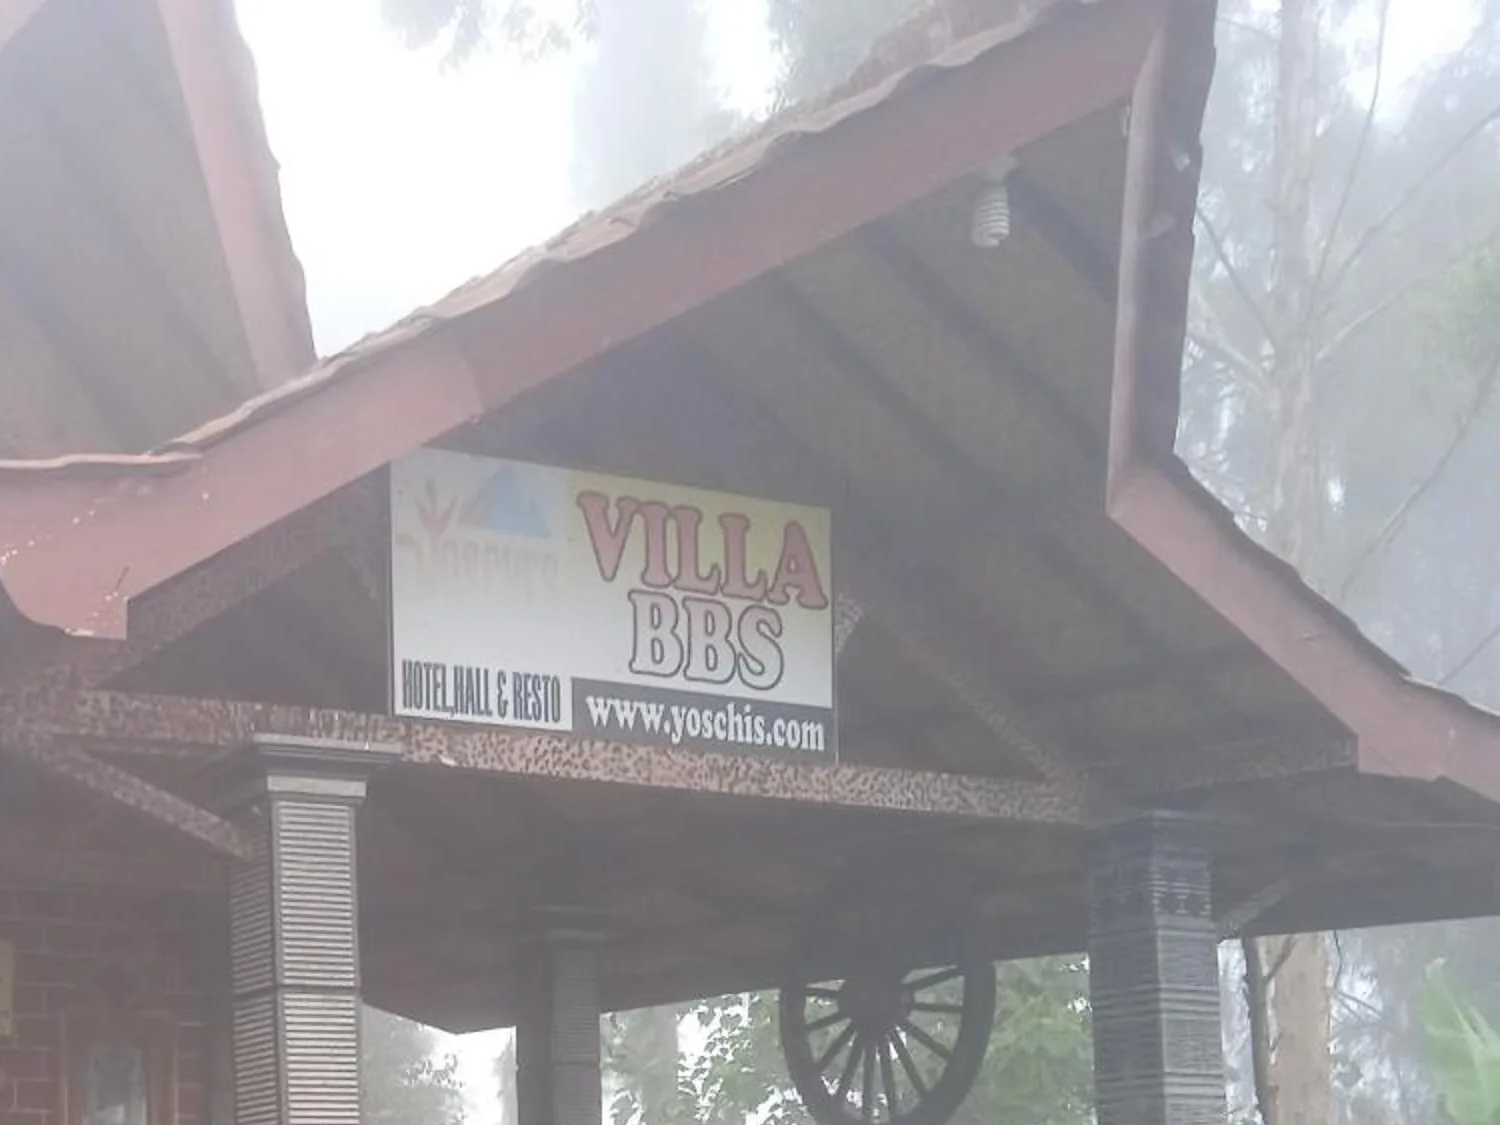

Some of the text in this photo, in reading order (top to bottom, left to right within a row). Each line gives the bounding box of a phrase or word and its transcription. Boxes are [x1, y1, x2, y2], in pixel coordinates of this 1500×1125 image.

[577, 491, 828, 610] VILLA
[629, 589, 784, 690] BBS
[512, 671, 560, 723] RESTO
[586, 696, 825, 750] www.yoschis.com
